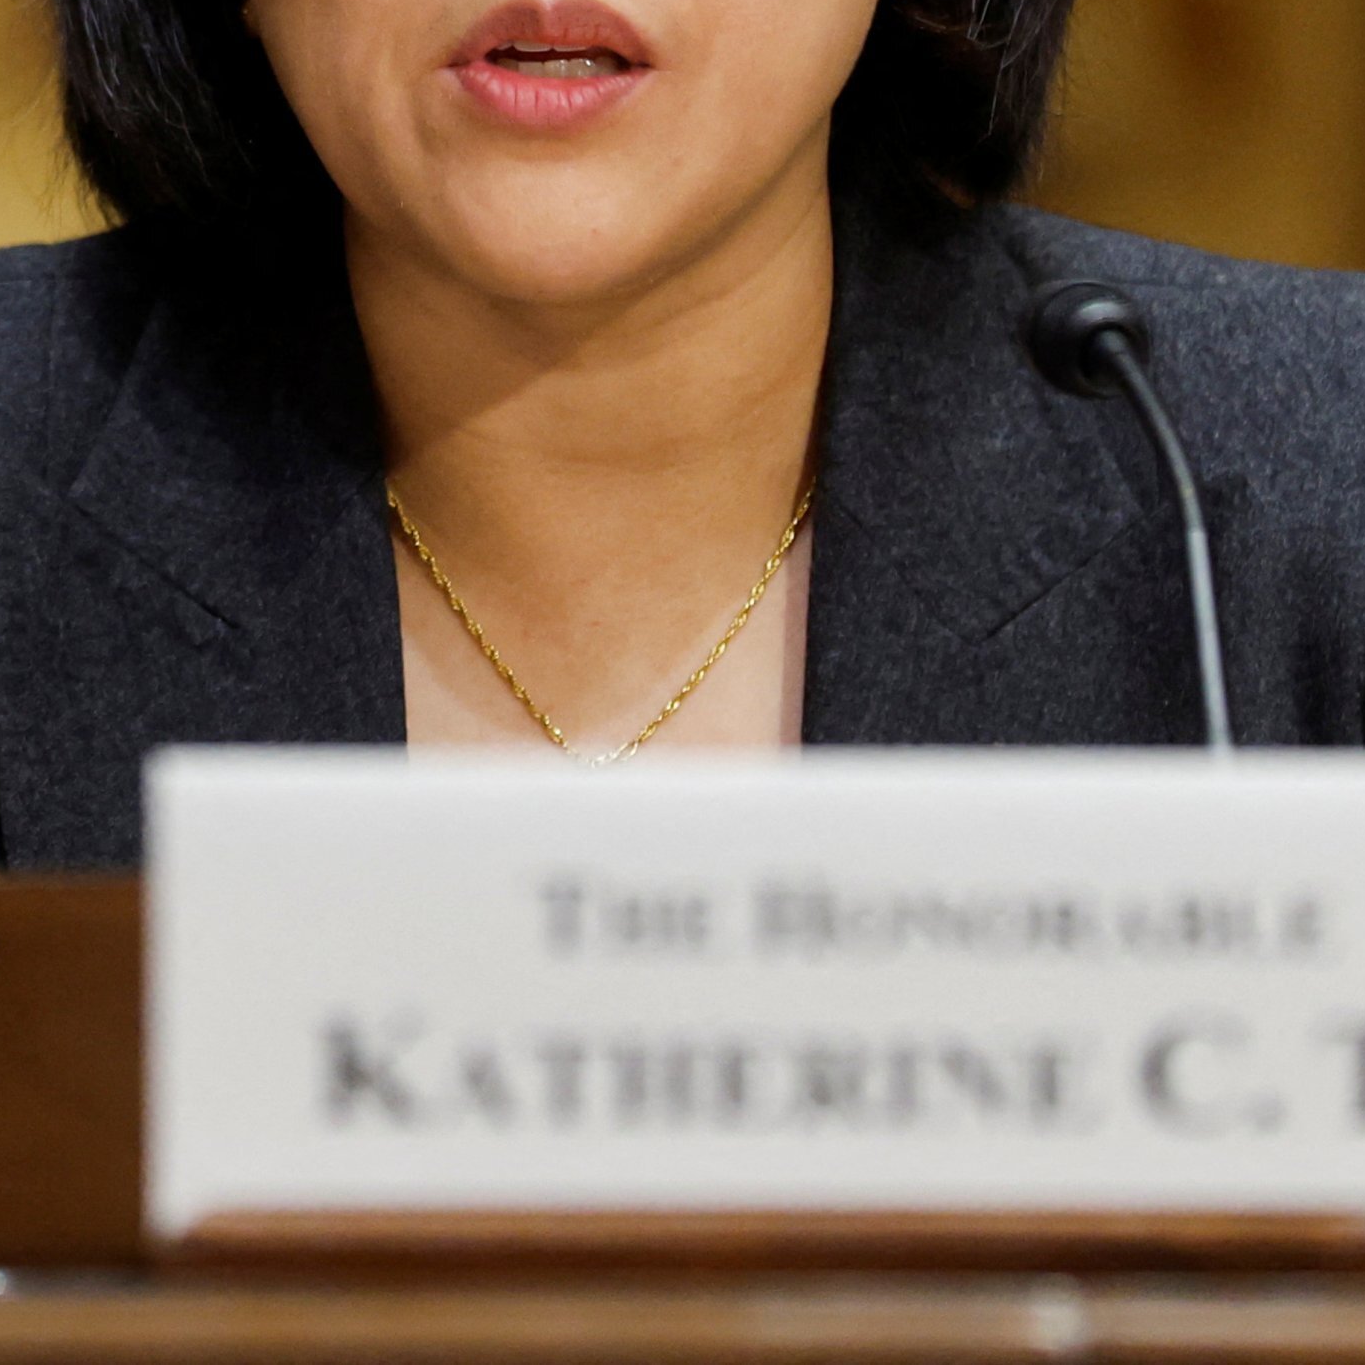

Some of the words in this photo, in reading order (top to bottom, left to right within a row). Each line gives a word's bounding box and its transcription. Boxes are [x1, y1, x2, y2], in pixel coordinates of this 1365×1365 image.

[535, 875, 717, 961] THE
[747, 875, 1335, 963] HONORABLE
[317, 1005, 1100, 1134] KATHERINE
[1133, 1005, 1288, 1137] C.
